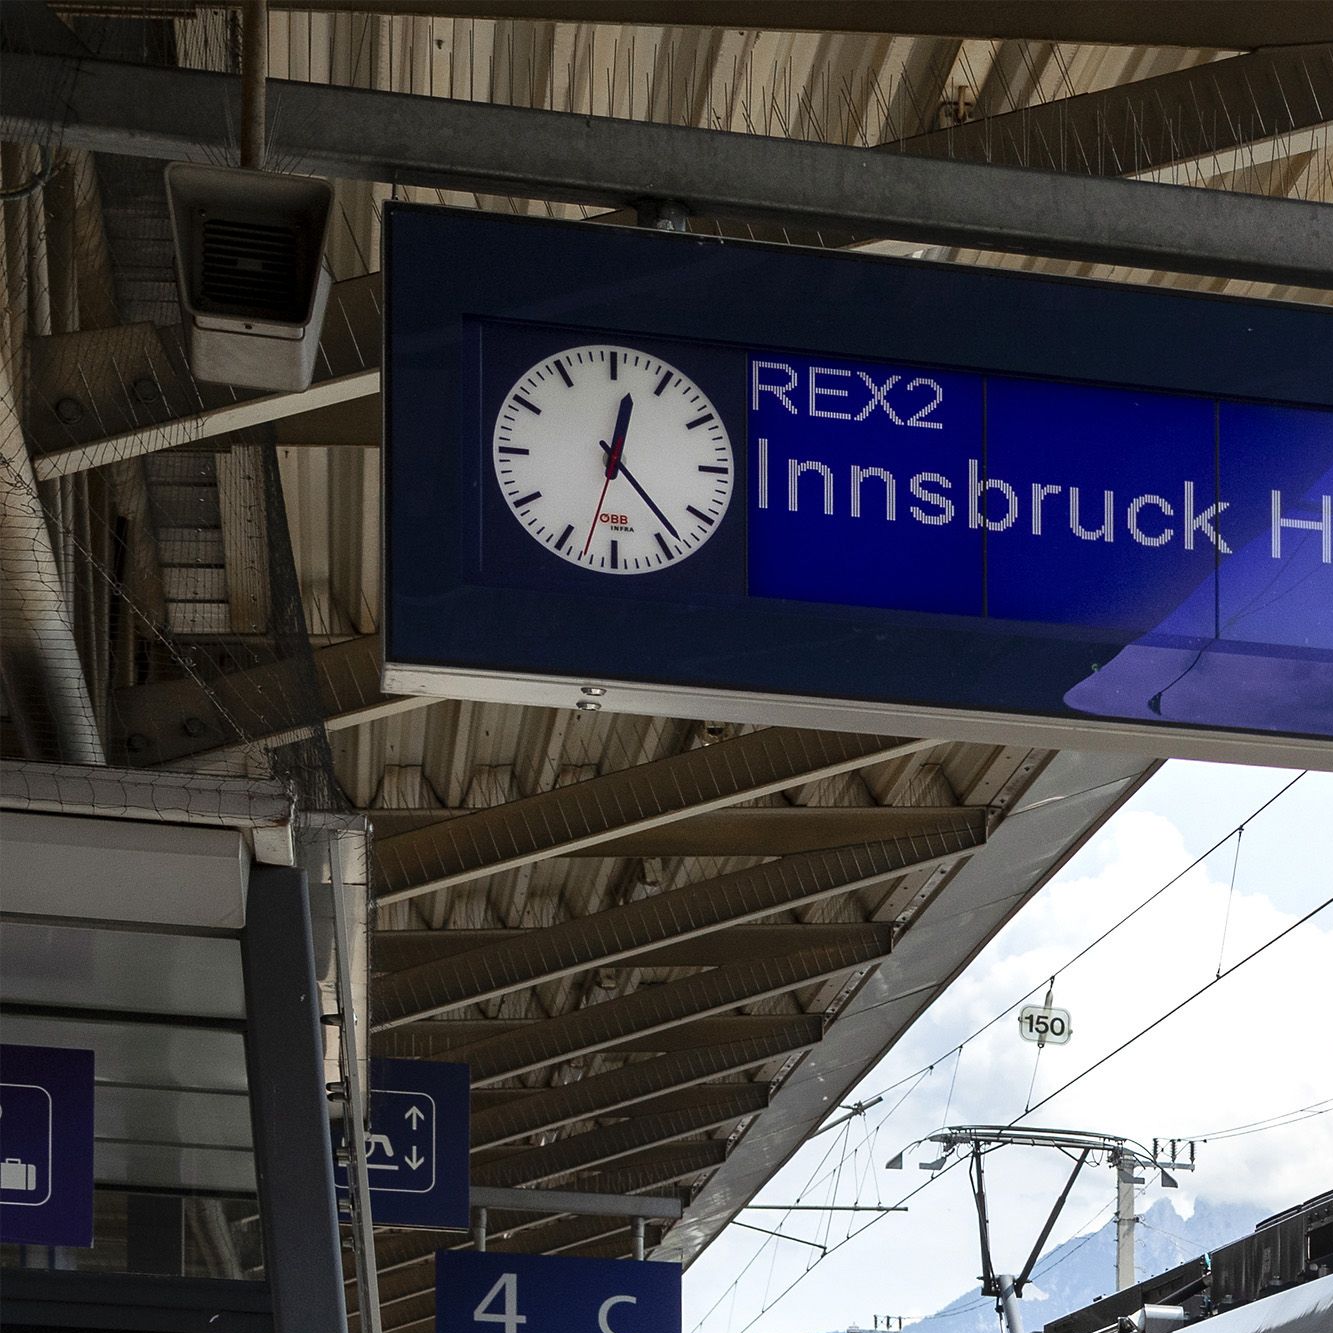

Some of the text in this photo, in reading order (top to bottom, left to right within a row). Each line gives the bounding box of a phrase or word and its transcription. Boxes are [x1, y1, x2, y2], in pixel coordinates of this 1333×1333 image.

[752, 359, 944, 430] REX2
[600, 513, 628, 525] ÖBB
[757, 438, 1233, 555] Innsbruck
[1024, 1014, 1066, 1037] 150
